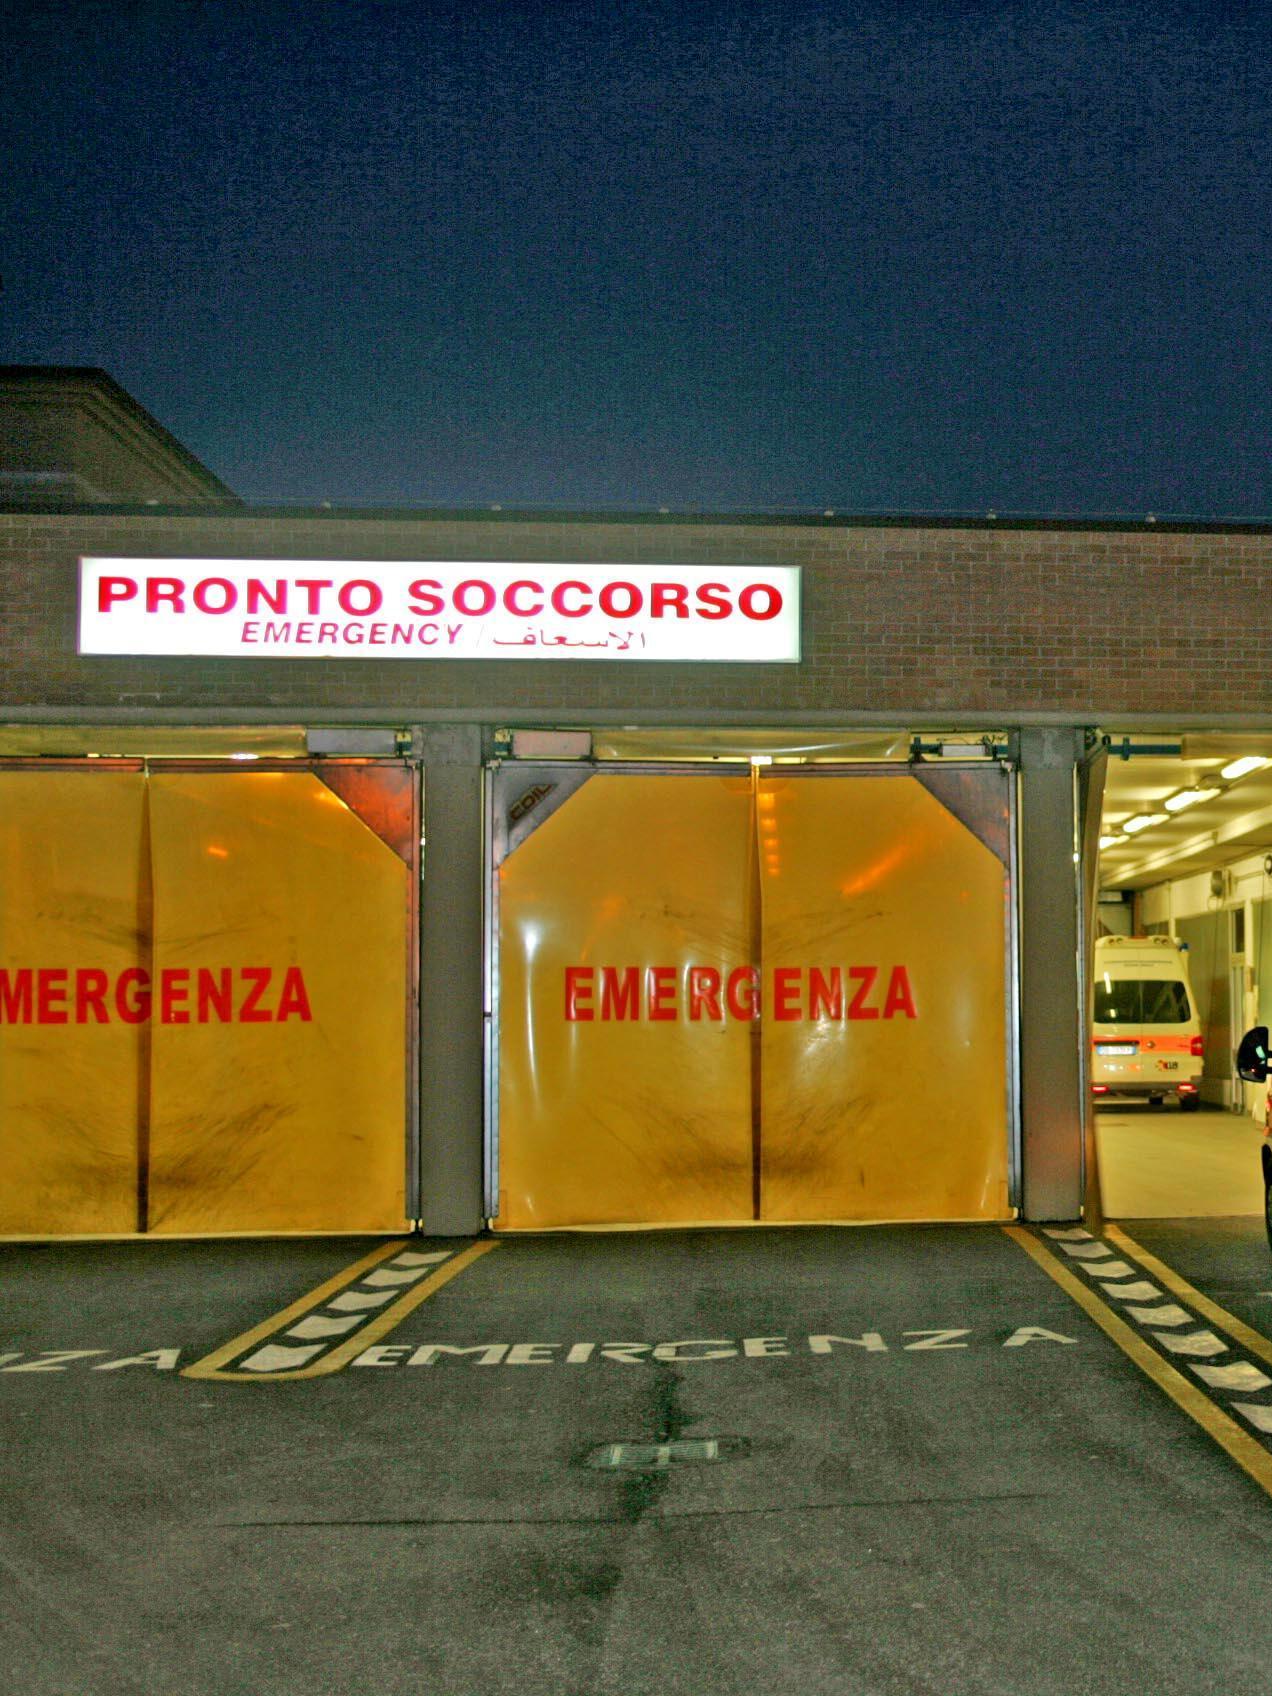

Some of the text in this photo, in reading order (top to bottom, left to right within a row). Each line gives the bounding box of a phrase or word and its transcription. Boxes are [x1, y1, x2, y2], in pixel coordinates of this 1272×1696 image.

[98, 575, 784, 621] PRONTO SOCCORSO
[240, 621, 464, 645] EMERGENCY
[0, 966, 313, 1024] MERGENZA
[563, 964, 918, 1022] EMERGENZA
[350, 1326, 1079, 1367] EMERGENZA
